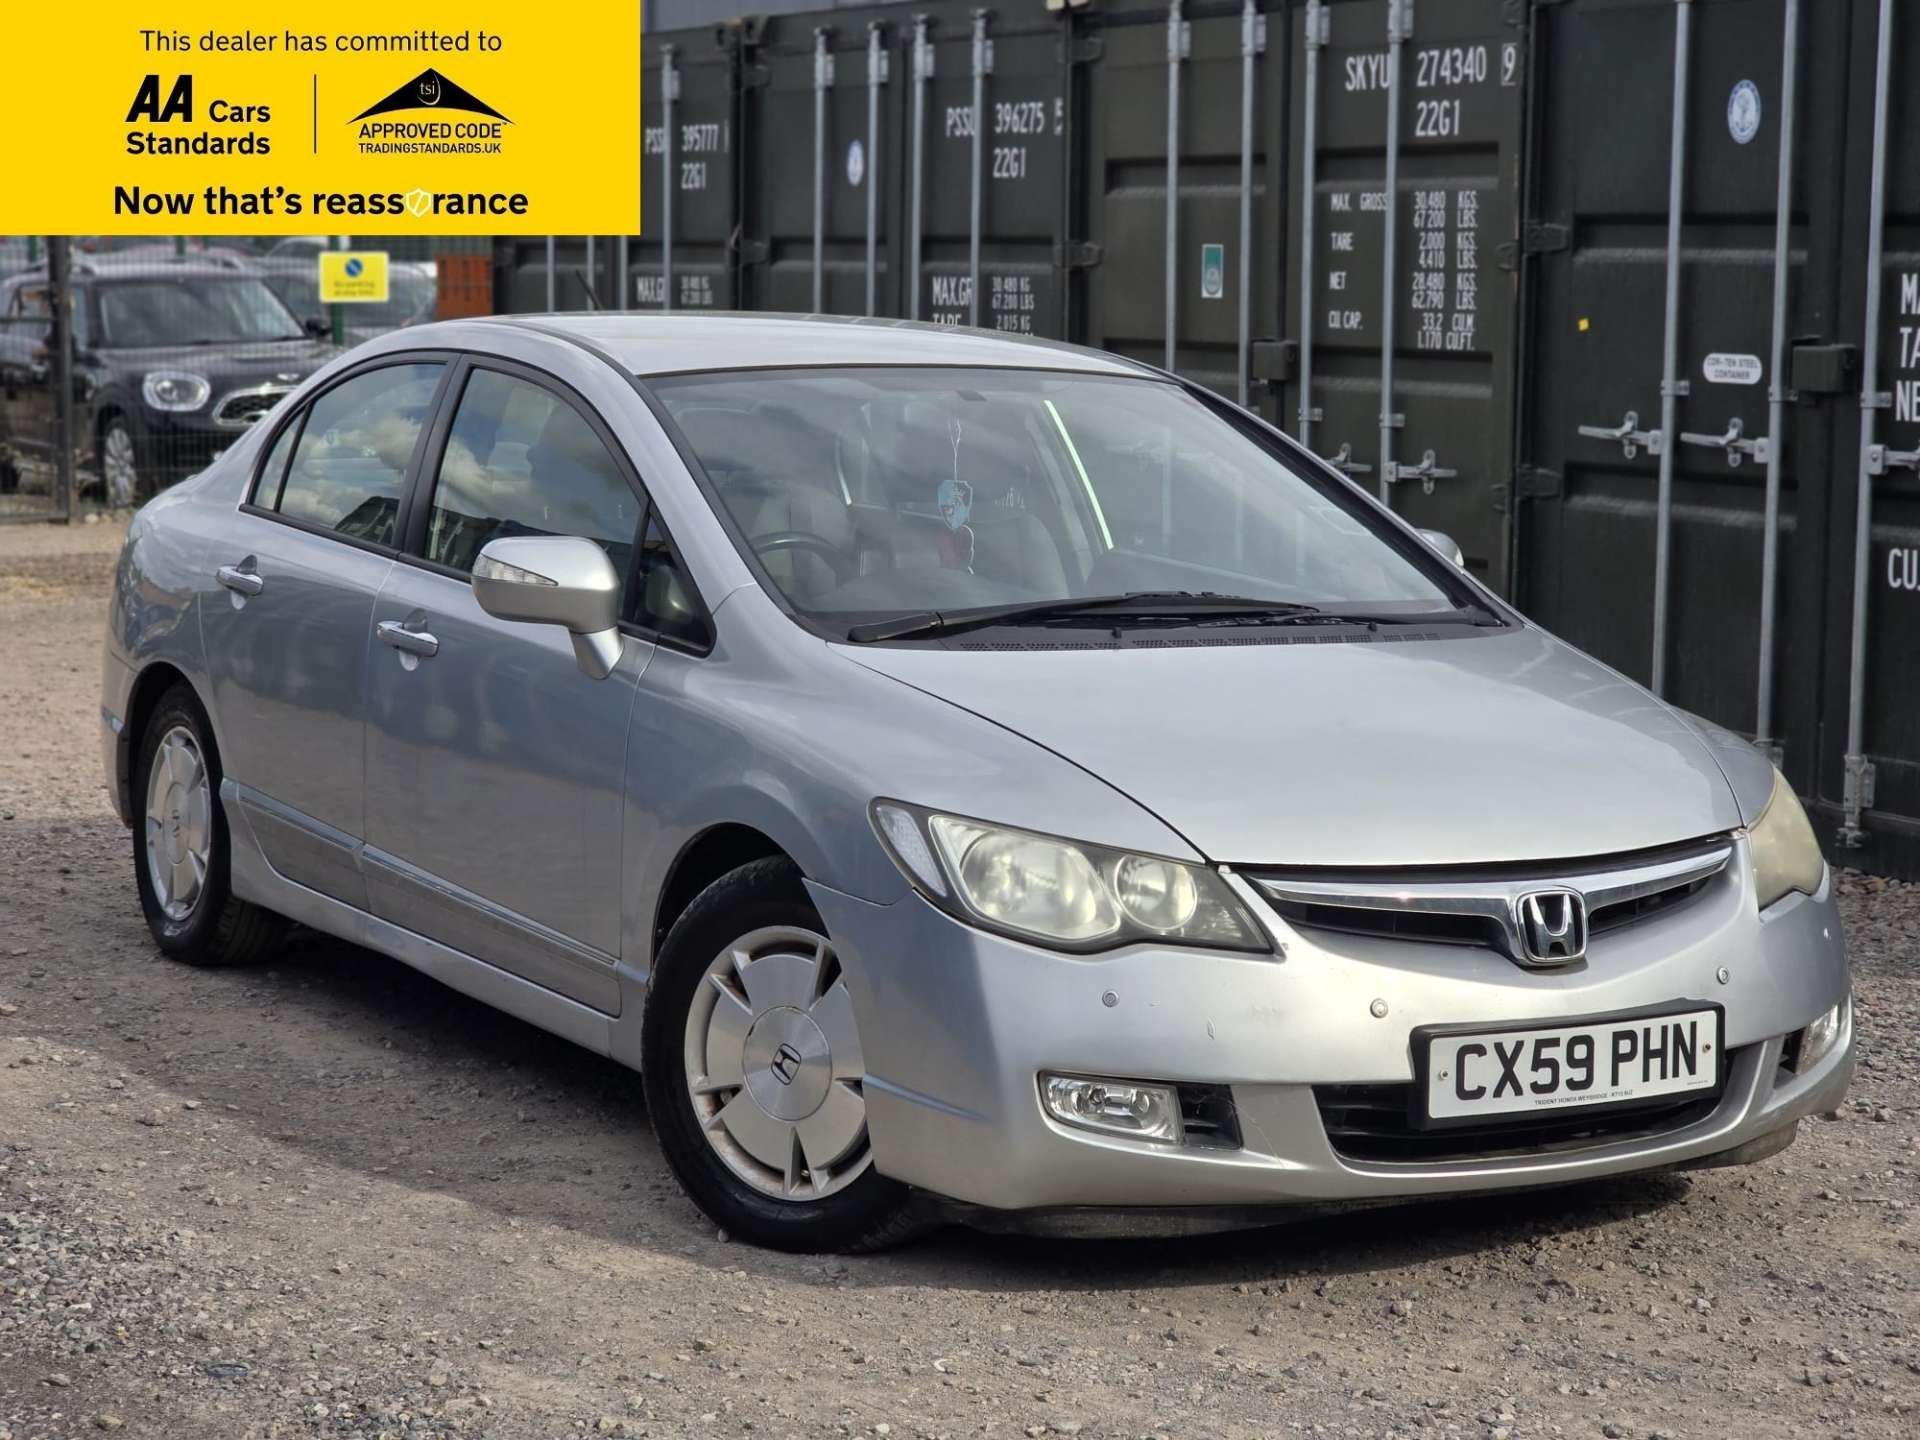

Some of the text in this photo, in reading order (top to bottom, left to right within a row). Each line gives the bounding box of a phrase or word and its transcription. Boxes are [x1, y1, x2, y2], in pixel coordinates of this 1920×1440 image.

[1345, 45, 1516, 91] SKYU 274340 9
[994, 101, 1044, 134] 396275
[1415, 99, 1461, 137] 22G1
[644, 126, 666, 154] PSS
[992, 146, 1027, 178] 22G1
[1455, 1020, 1698, 1101] CX59 PHN
